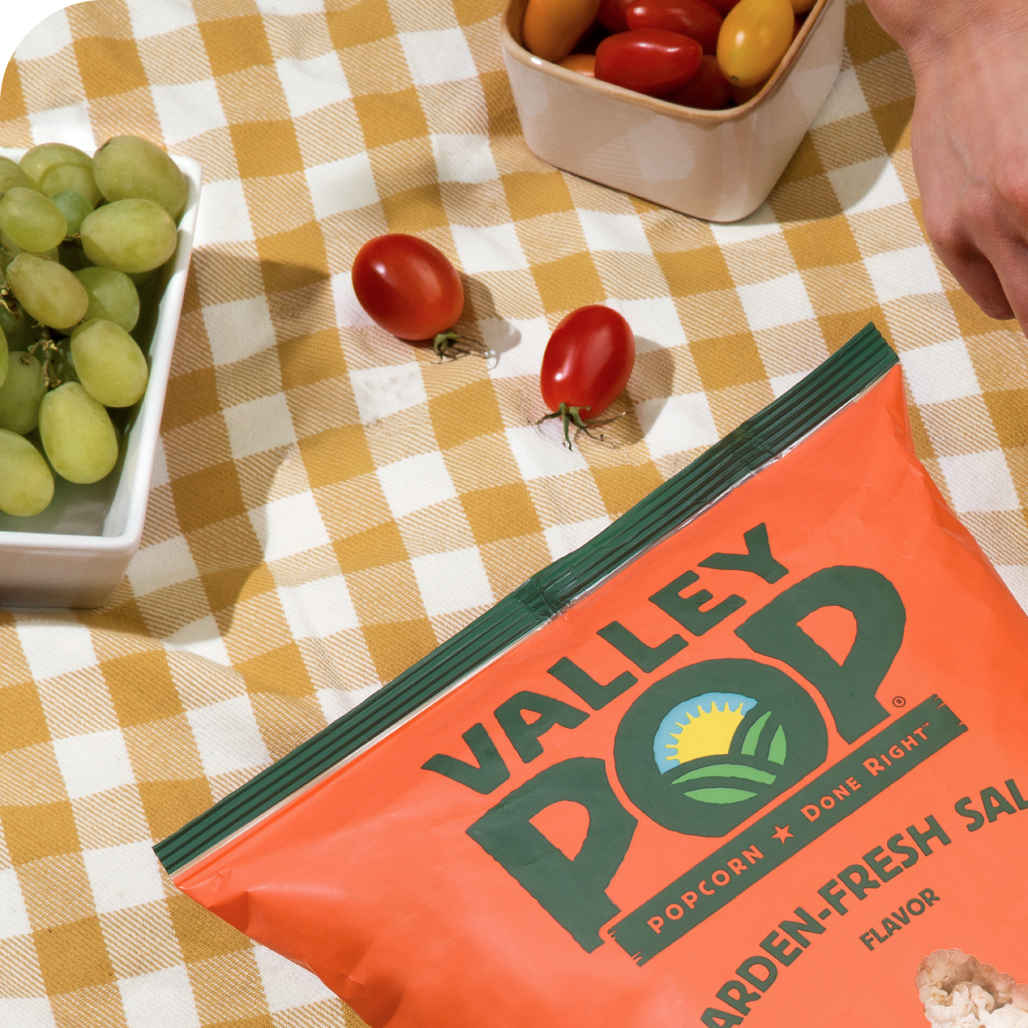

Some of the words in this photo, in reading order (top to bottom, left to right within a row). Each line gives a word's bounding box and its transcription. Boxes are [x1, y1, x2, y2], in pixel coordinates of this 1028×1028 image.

[421, 523, 789, 794] VALLEY
[465, 565, 906, 953] POP
[647, 845, 764, 933] POPCORN
[801, 777, 860, 821] DONE
[860, 889, 940, 950] FLAVOR
